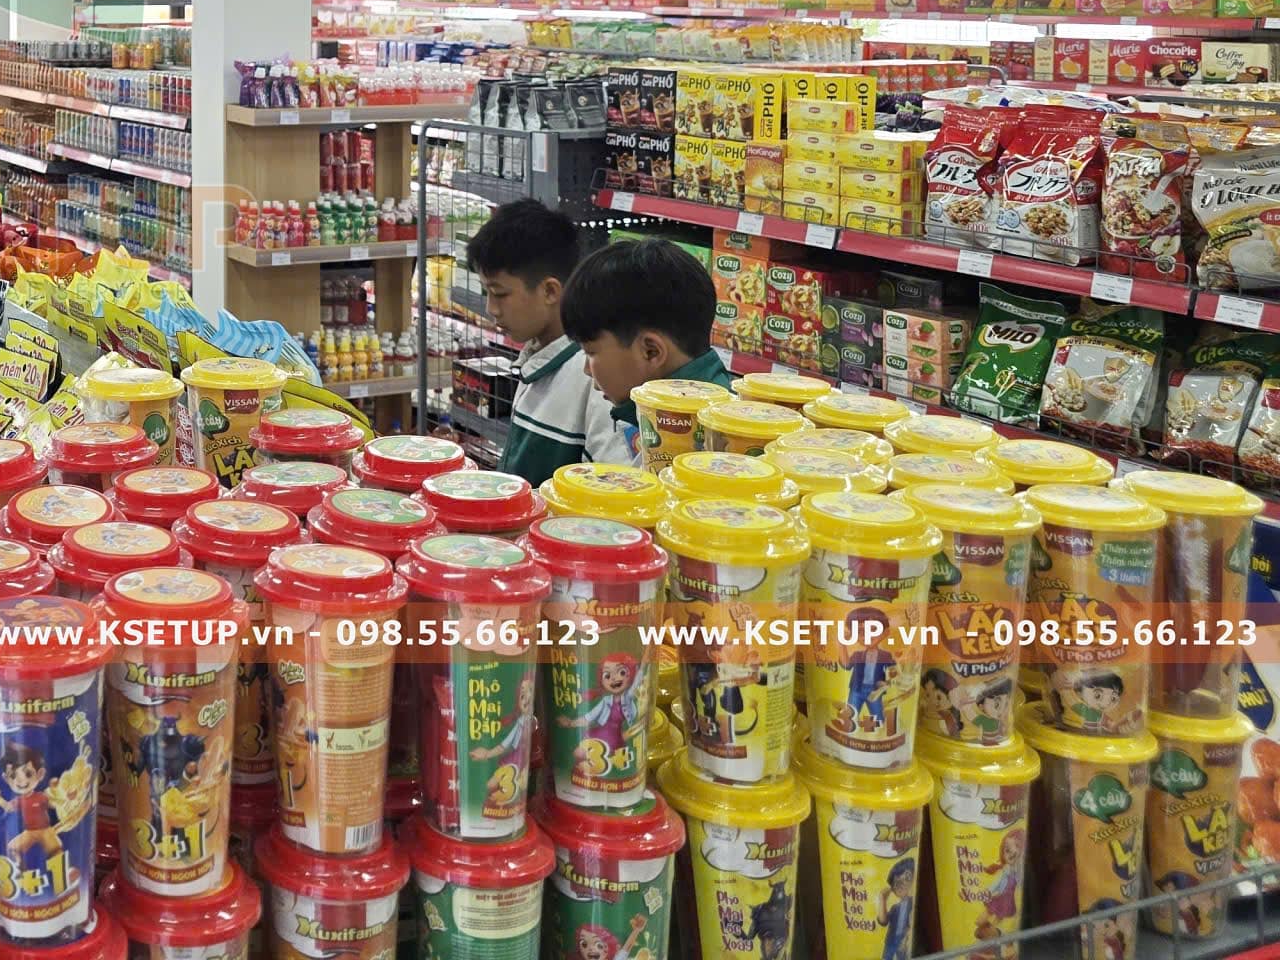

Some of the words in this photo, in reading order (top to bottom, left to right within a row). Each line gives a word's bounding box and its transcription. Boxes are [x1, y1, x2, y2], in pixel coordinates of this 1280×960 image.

[1055, 41, 1086, 56] Marie
[1109, 43, 1141, 57] Marie
[717, 256, 740, 271] Cozy
[771, 268, 793, 283] Cozy
[716, 303, 737, 318] Cozy
[843, 309, 864, 323] Cozy
[768, 317, 791, 332] Cozy
[886, 315, 907, 329] Cozy
[988, 325, 1037, 344] MILO
[842, 349, 863, 363] Cozy
[886, 355, 906, 369] Cozy
[223, 397, 260, 409] VISSAN
[656, 415, 693, 428] VISSAN
[1045, 531, 1094, 548] VISSAN
[954, 544, 1005, 557] VISSAN
[468, 678, 501, 698] Phô
[469, 699, 502, 721] Mai
